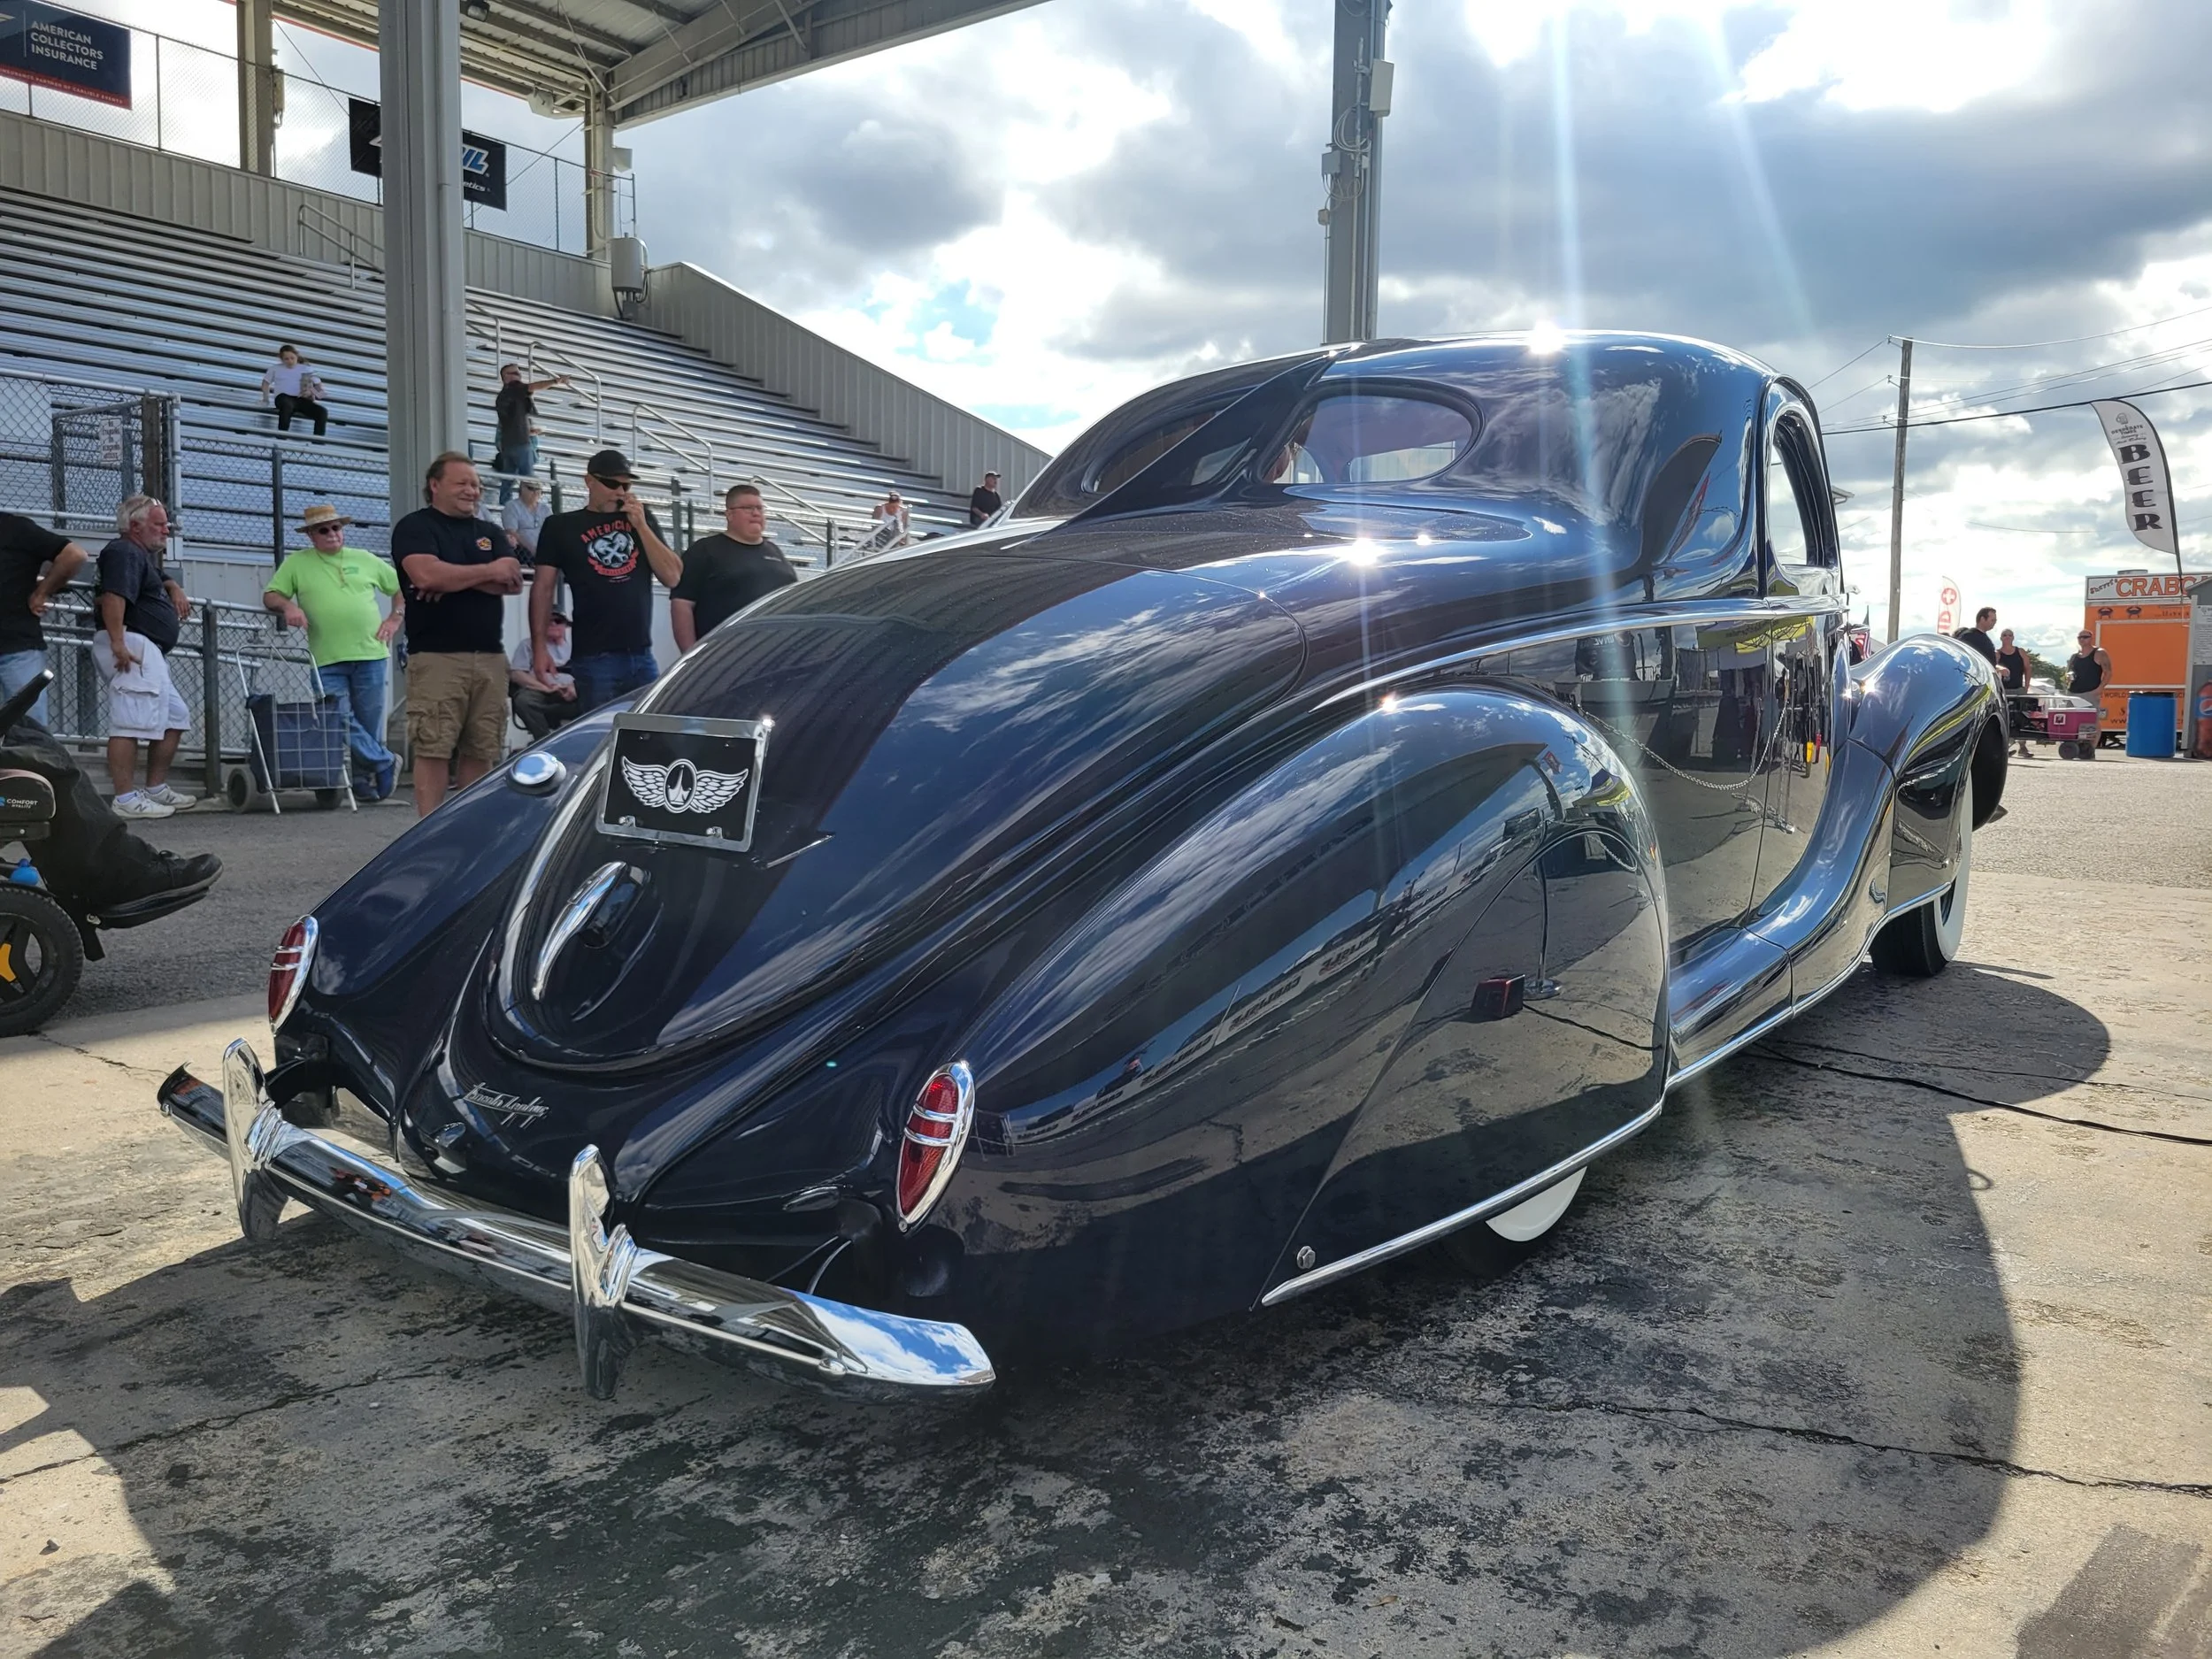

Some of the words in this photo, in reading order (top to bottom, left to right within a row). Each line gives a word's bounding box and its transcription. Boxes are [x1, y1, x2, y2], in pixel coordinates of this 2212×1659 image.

[31, 21, 91, 44] AMERICAN
[31, 33, 104, 60] COLLECTORS
[31, 44, 97, 70] INSURANCE
[2117, 444, 2163, 532] BEER
